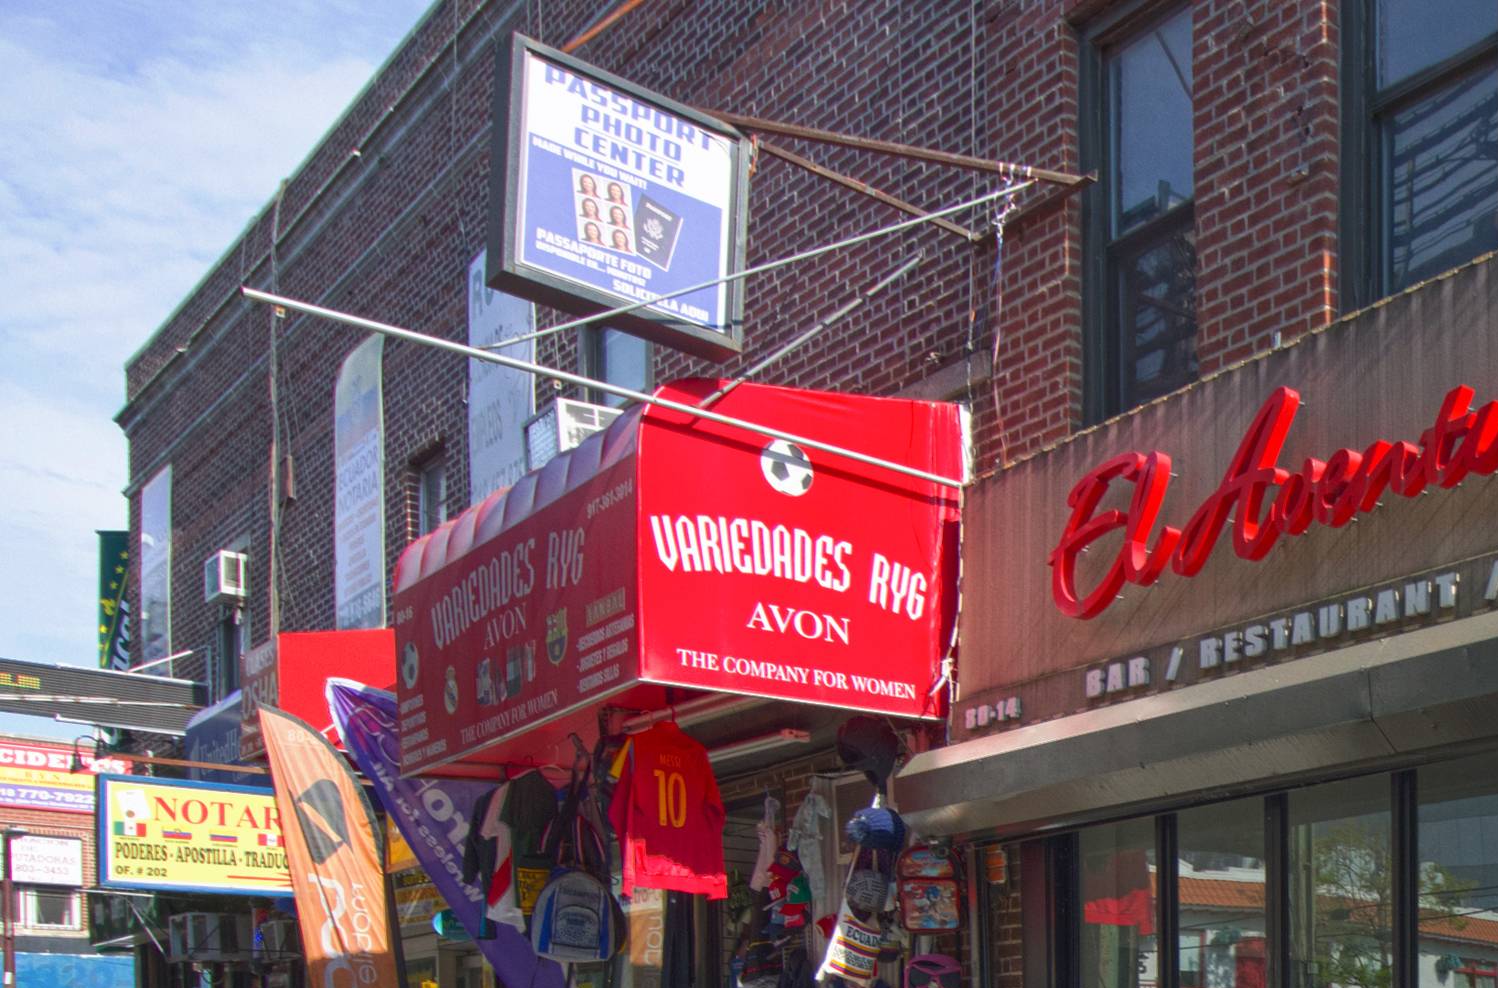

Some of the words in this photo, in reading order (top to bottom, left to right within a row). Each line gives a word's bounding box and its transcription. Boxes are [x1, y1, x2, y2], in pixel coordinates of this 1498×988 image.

[545, 64, 711, 150] PASSPORT
[581, 104, 681, 161] PHOTO
[575, 127, 685, 187] CENTER
[620, 258, 651, 279] FOTO
[1047, 450, 1182, 620] El
[431, 538, 535, 649] VARIEDADES
[546, 527, 585, 589] RYG
[650, 515, 852, 592] VARIEDADES
[868, 553, 927, 621] RYG
[483, 602, 527, 650] AVON
[747, 602, 850, 645] AVON
[1086, 656, 1150, 698] BAR
[1165, 646, 1183, 681] /
[1200, 571, 1460, 669] RESTAURANT
[676, 648, 719, 671] THE
[723, 656, 809, 684] COMPANY
[814, 669, 848, 690] FOR
[851, 675, 916, 699] WOMEN
[460, 725, 476, 744] THE
[477, 711, 511, 738] COMPANY
[512, 706, 526, 724] FOR
[527, 689, 558, 713] WOMEN
[965, 696, 1023, 729] 80-14
[659, 754, 681, 768] MESSI
[154, 796, 282, 830] NOTAR
[654, 769, 686, 828] 10
[115, 842, 167, 861] PODERES
[176, 847, 237, 866] APOSTILLA
[245, 852, 290, 869] TRADUC
[115, 866, 133, 876] OF.
[147, 867, 167, 877] 202
